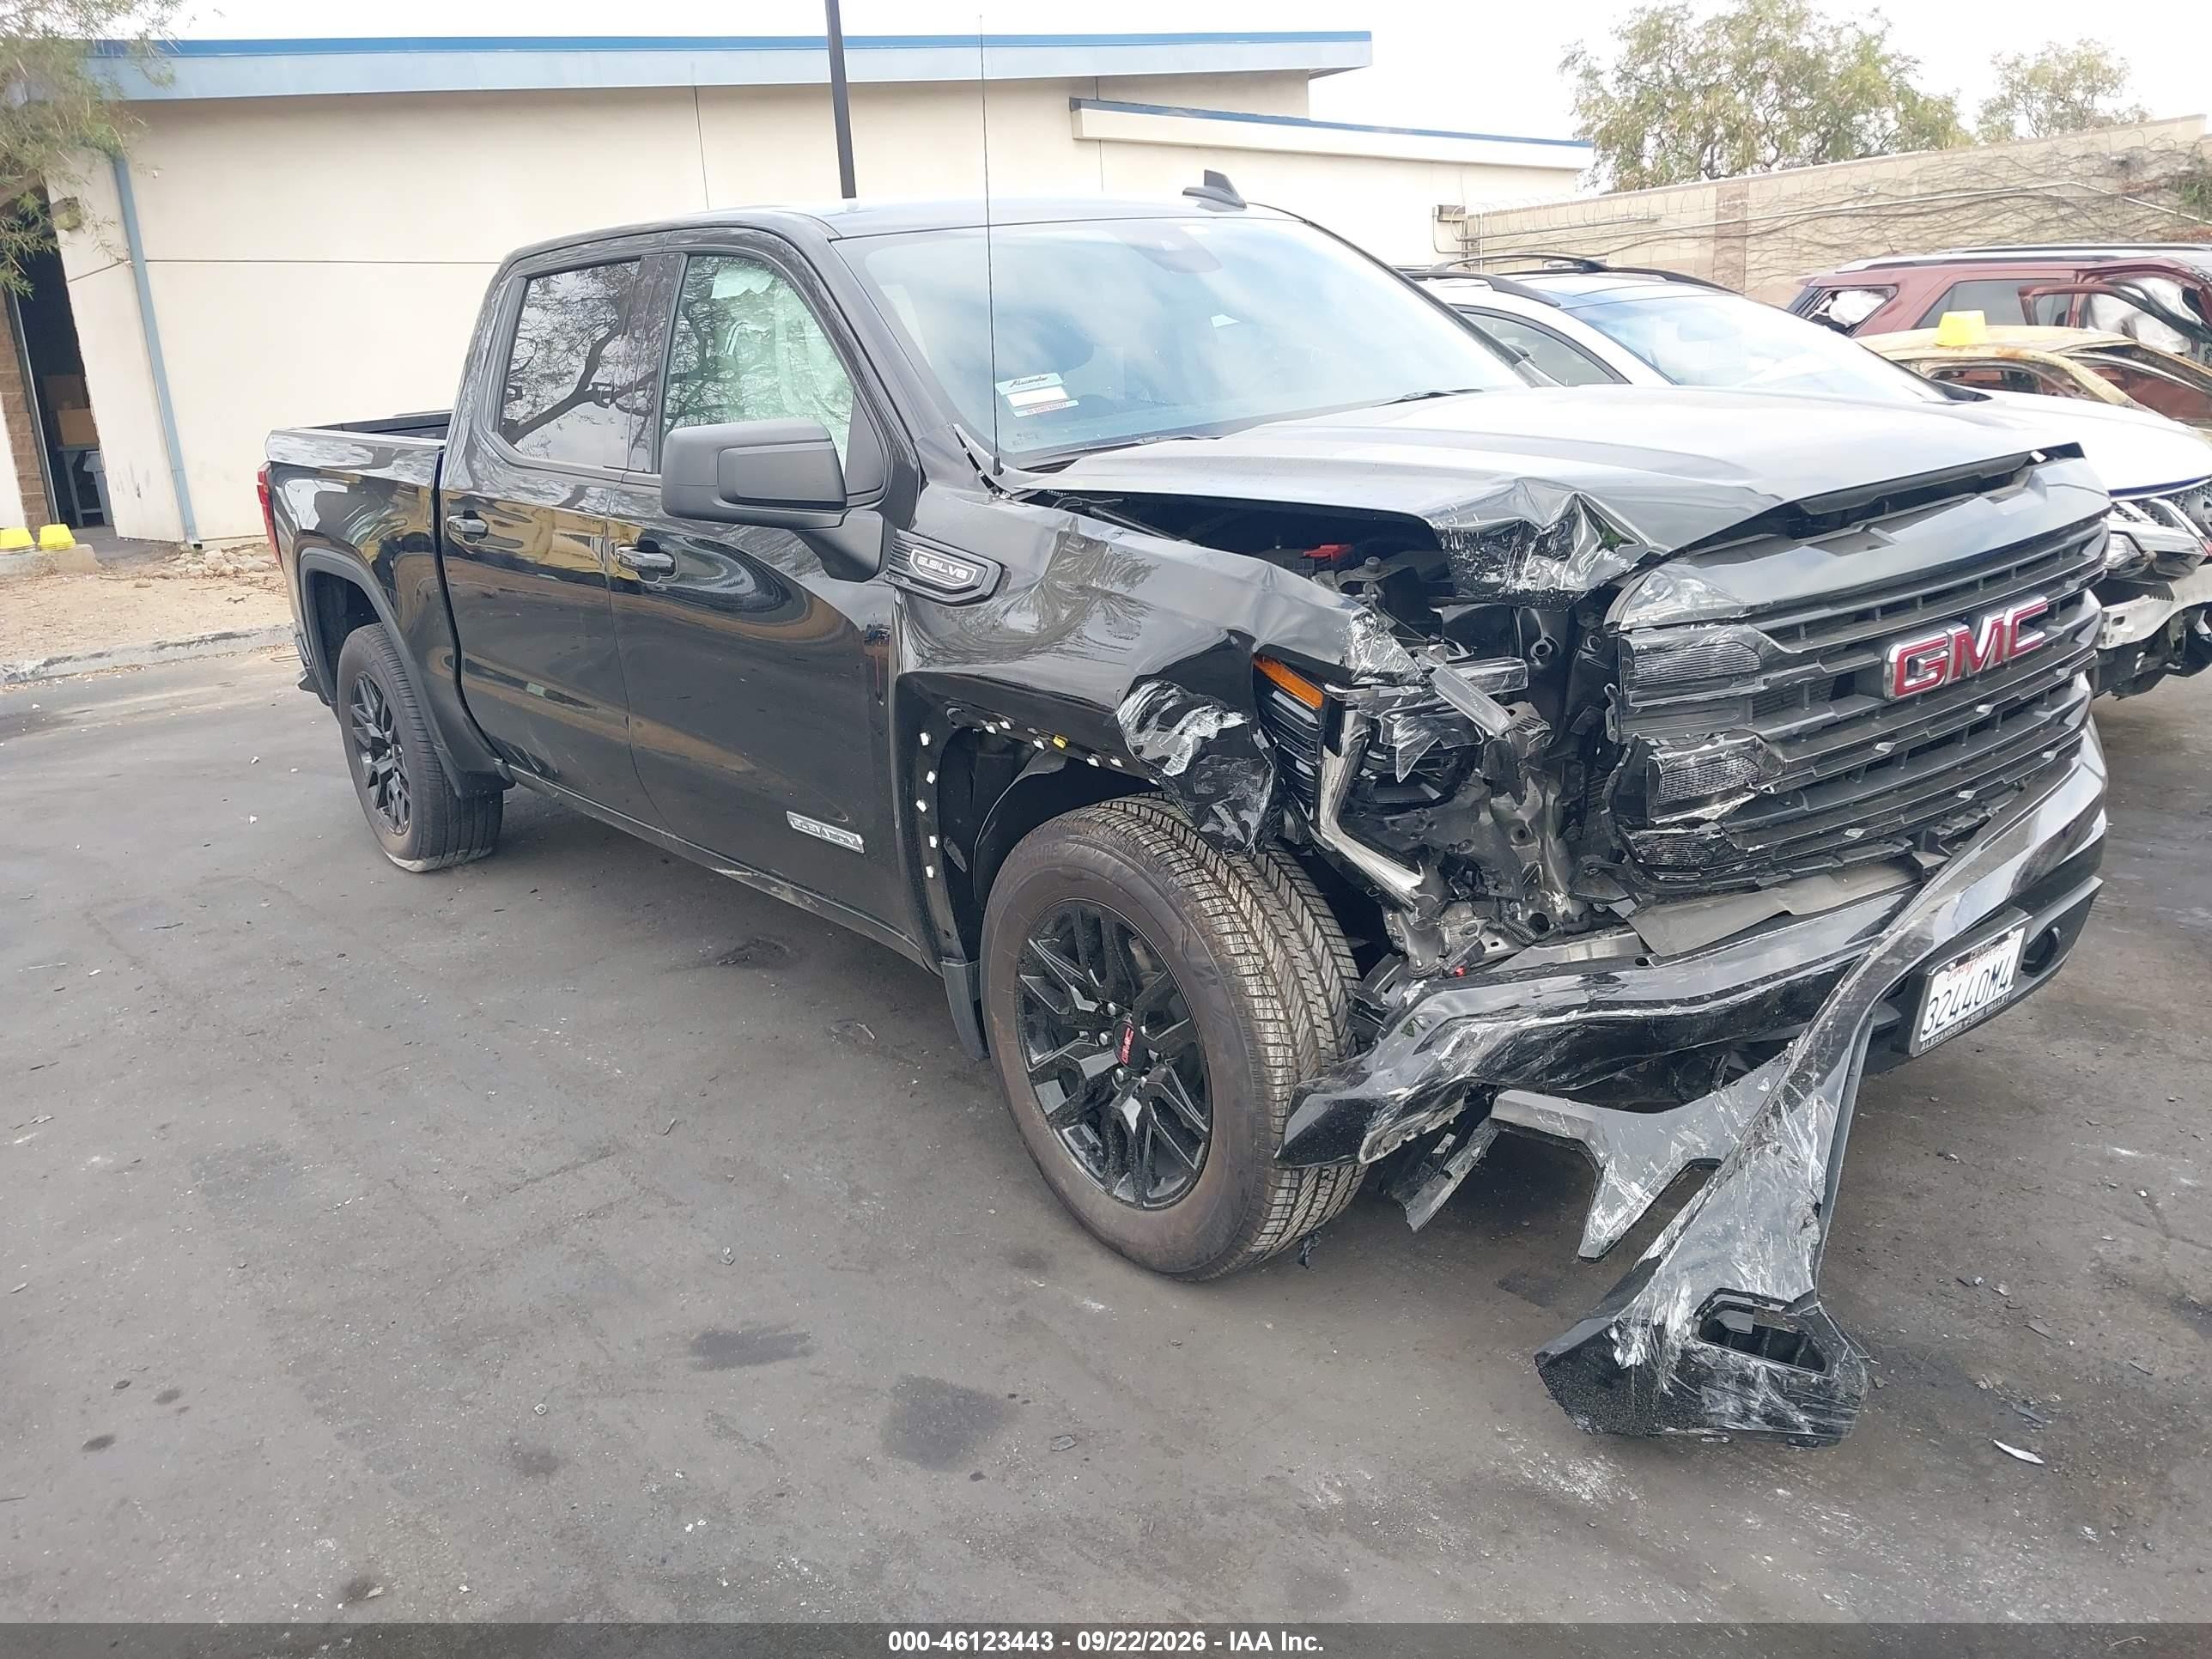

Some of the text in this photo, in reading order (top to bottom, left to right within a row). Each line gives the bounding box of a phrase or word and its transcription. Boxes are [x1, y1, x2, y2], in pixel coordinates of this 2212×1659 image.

[1885, 596, 2048, 699] GMC
[1922, 955, 2012, 1035] 32440M4
[1121, 1026, 1134, 1064] GMC
